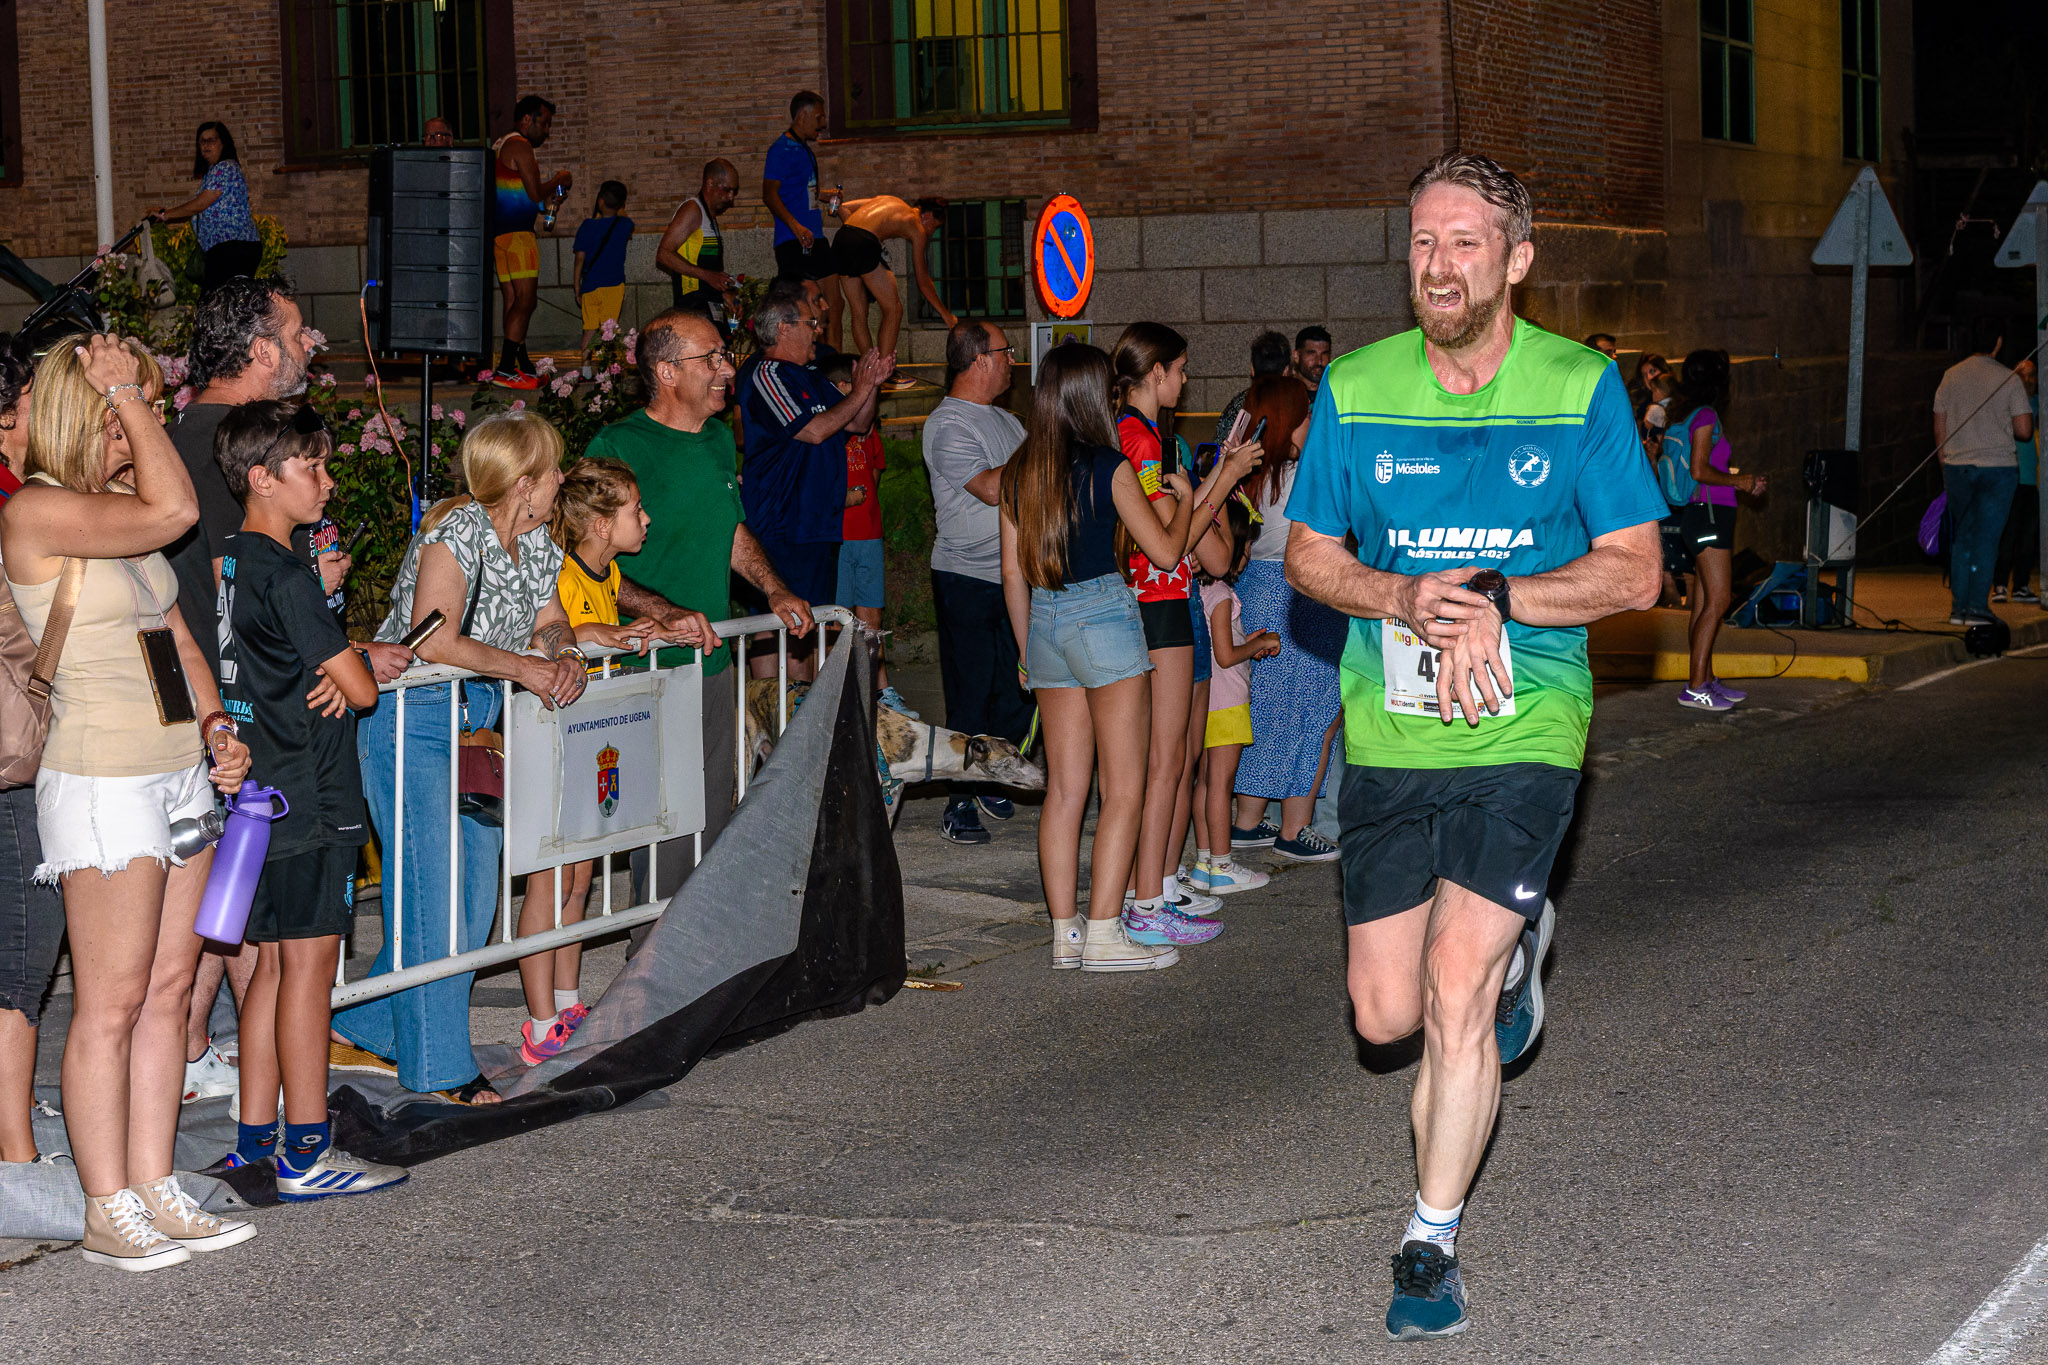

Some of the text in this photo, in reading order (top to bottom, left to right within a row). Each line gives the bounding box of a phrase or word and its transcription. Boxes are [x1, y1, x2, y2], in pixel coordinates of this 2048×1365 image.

[1395, 462, 1441, 475] Móstoles
[1387, 527, 1534, 549] ILUMINA
[1478, 550, 1511, 560] 2025
[567, 710, 651, 735] AYUNTAMIENTO DE UGENA
